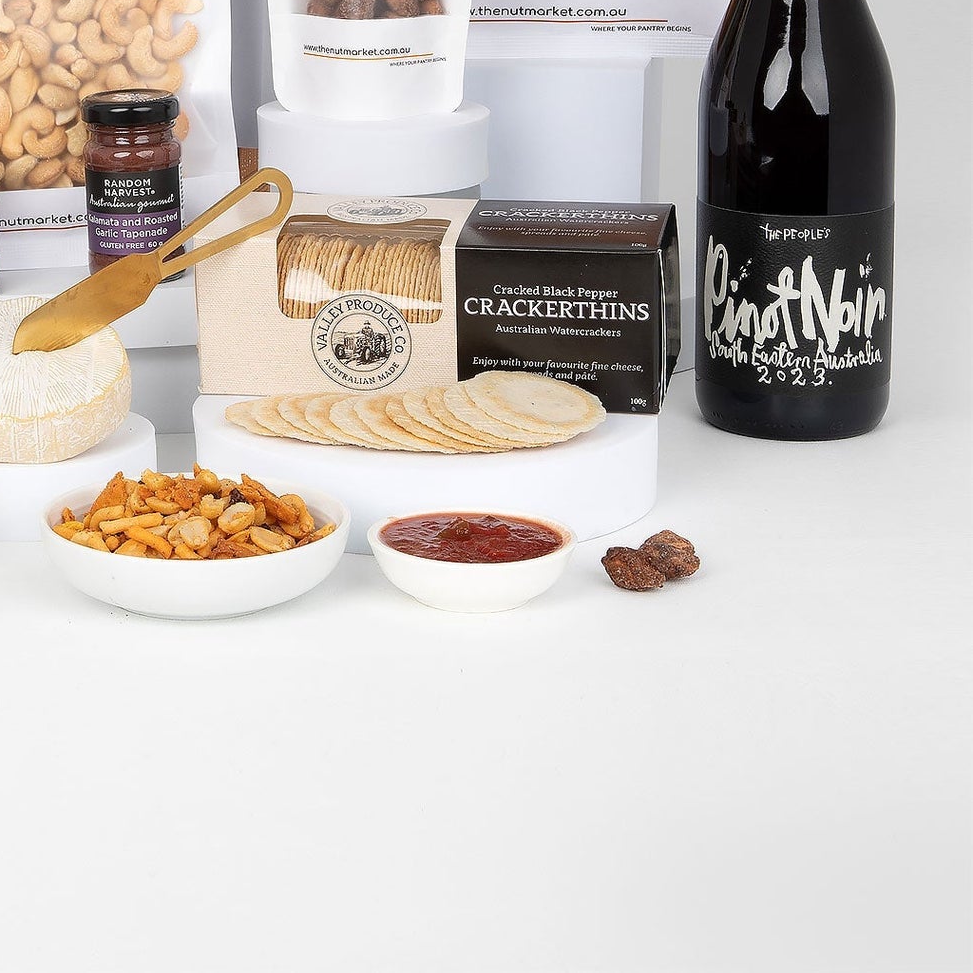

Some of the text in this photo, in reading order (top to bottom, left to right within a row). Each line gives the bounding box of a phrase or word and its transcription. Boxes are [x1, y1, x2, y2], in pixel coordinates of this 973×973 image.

[469, 5, 627, 17] .thenutmarket.com.au
[591, 25, 691, 33] WHERE YOUR PANTRY BEGINS
[104, 179, 151, 188] RANDOM
[89, 193, 175, 213] Australian gourmet
[122, 217, 142, 227] and
[144, 211, 178, 225] Roasted
[479, 210, 659, 222] CRACKERTHINS
[95, 227, 168, 239] Garlic Tapenade
[783, 227, 831, 241] PEOPLE'S
[99, 241, 125, 249] GLUTEN
[493, 284, 619, 301] Cracked Black Pepper
[704, 235, 801, 349] Pinot
[463, 297, 651, 321] CRACKERTHINS
[317, 302, 345, 352] VALLEY
[345, 298, 403, 335] PRODUCE
[495, 323, 621, 338] Australian Watercrackers
[709, 330, 883, 373] South Eastern Australia
[323, 357, 401, 385] AUSTRALIAN MADE
[472, 357, 645, 373] Enjoy with your favourite fine cheese,
[555, 371, 598, 381] and pâté.
[630, 397, 647, 407] 100g
